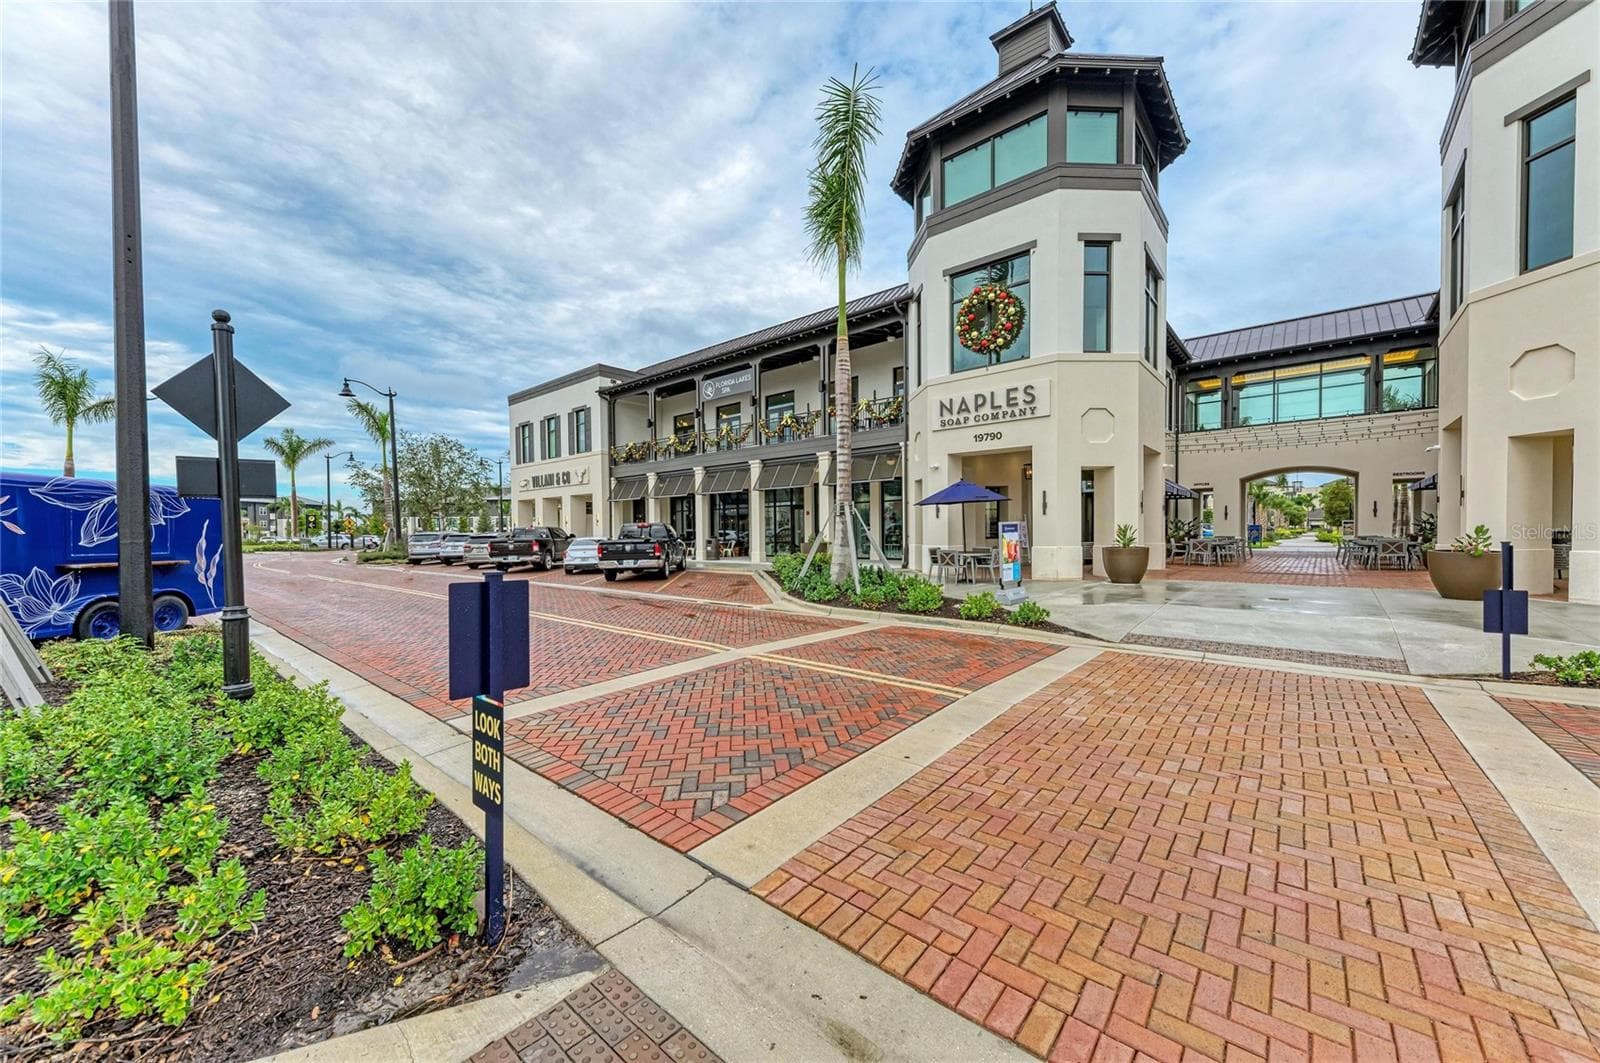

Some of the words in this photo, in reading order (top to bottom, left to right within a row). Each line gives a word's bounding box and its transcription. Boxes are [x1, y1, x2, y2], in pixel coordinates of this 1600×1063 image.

[715, 379, 736, 389] FLORIDA
[939, 384, 1037, 417] NAPLES
[940, 416, 970, 427] SOAP
[974, 406, 1037, 423] COMPANY
[973, 431, 1003, 443] 19790
[474, 710, 501, 741] LOOK
[474, 741, 501, 773] BOTH
[474, 769, 501, 805] WAYS
